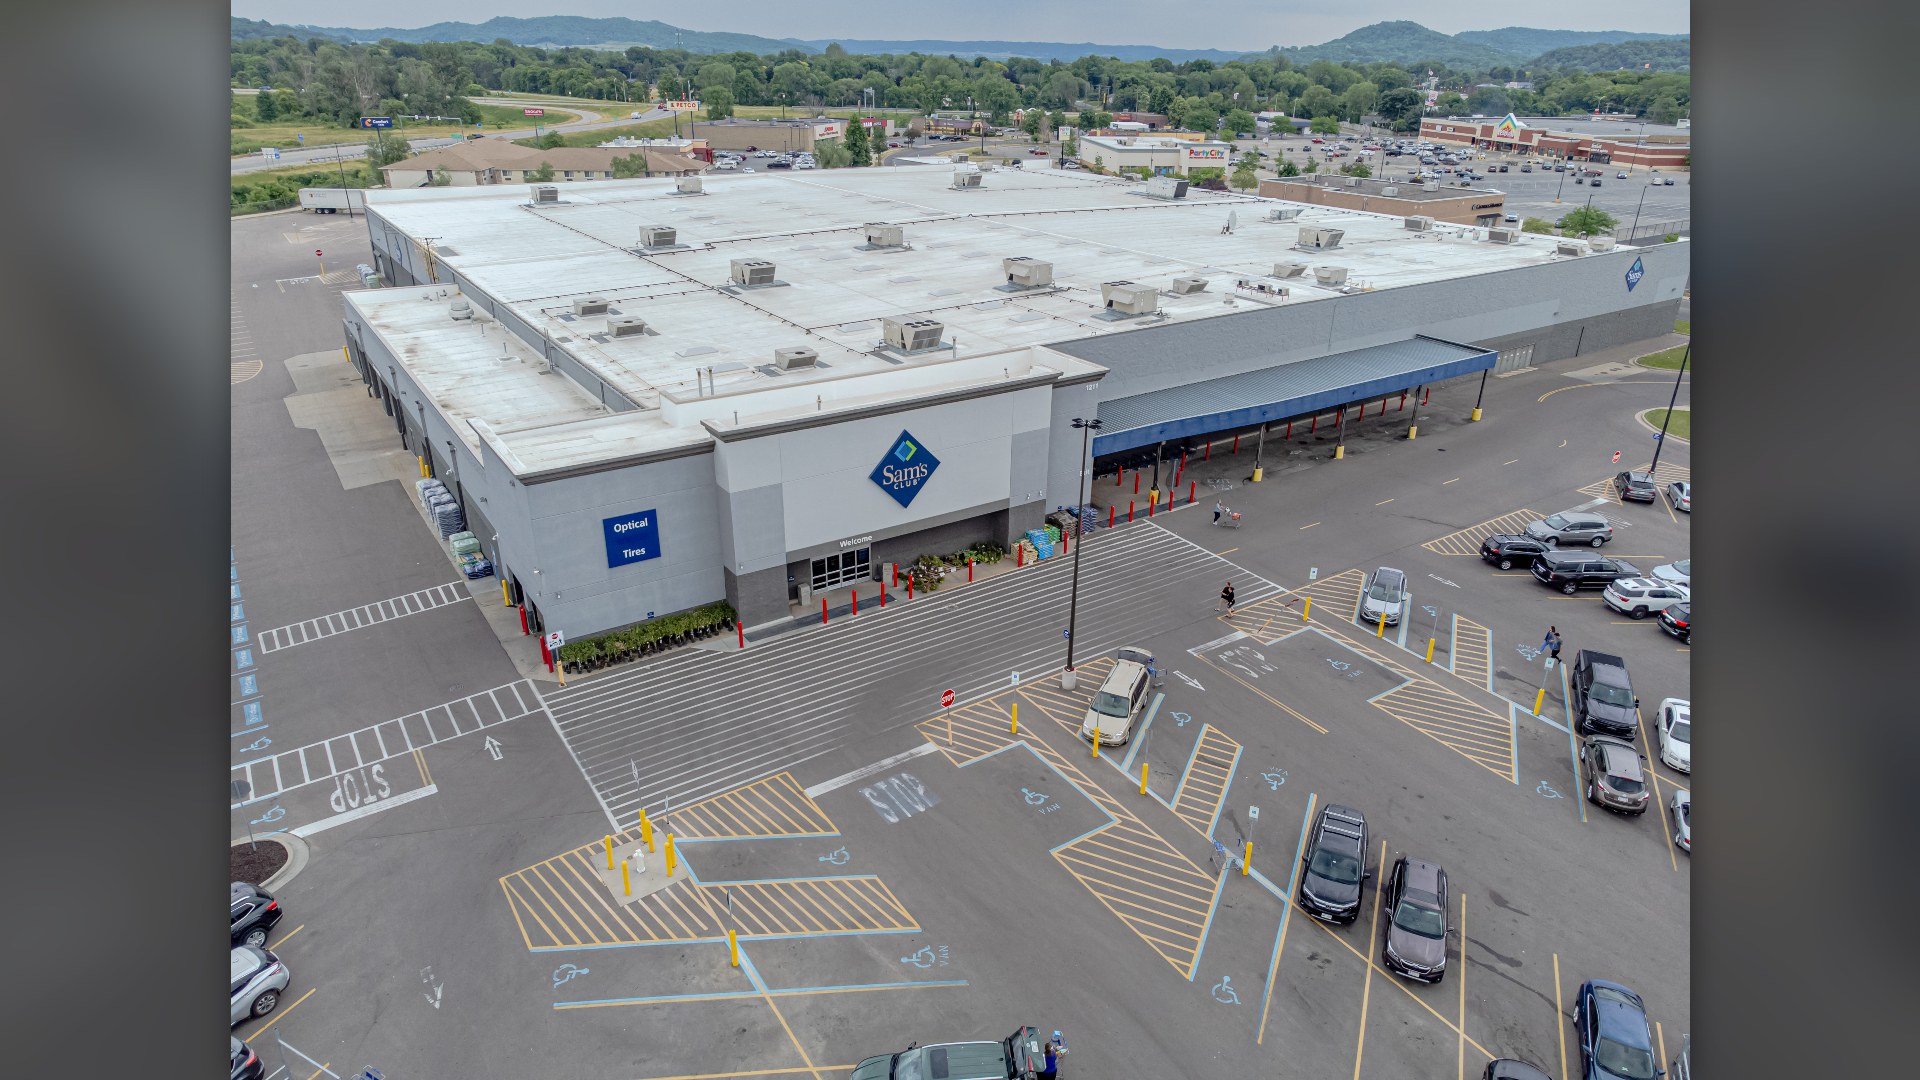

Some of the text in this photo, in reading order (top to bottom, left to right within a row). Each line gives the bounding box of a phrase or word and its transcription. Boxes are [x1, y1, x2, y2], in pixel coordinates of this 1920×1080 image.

[1189, 149, 1225, 157] Party City
[1085, 382, 1099, 391] 1211
[882, 462, 928, 486] Sam's
[893, 478, 918, 490] CLUB
[613, 517, 648, 533] Optical
[839, 535, 873, 548] Welcome
[622, 547, 646, 558] Tires
[941, 692, 954, 704] STOP
[330, 764, 391, 813] STOP
[861, 772, 933, 823] STOP
[938, 944, 949, 967] VAN
